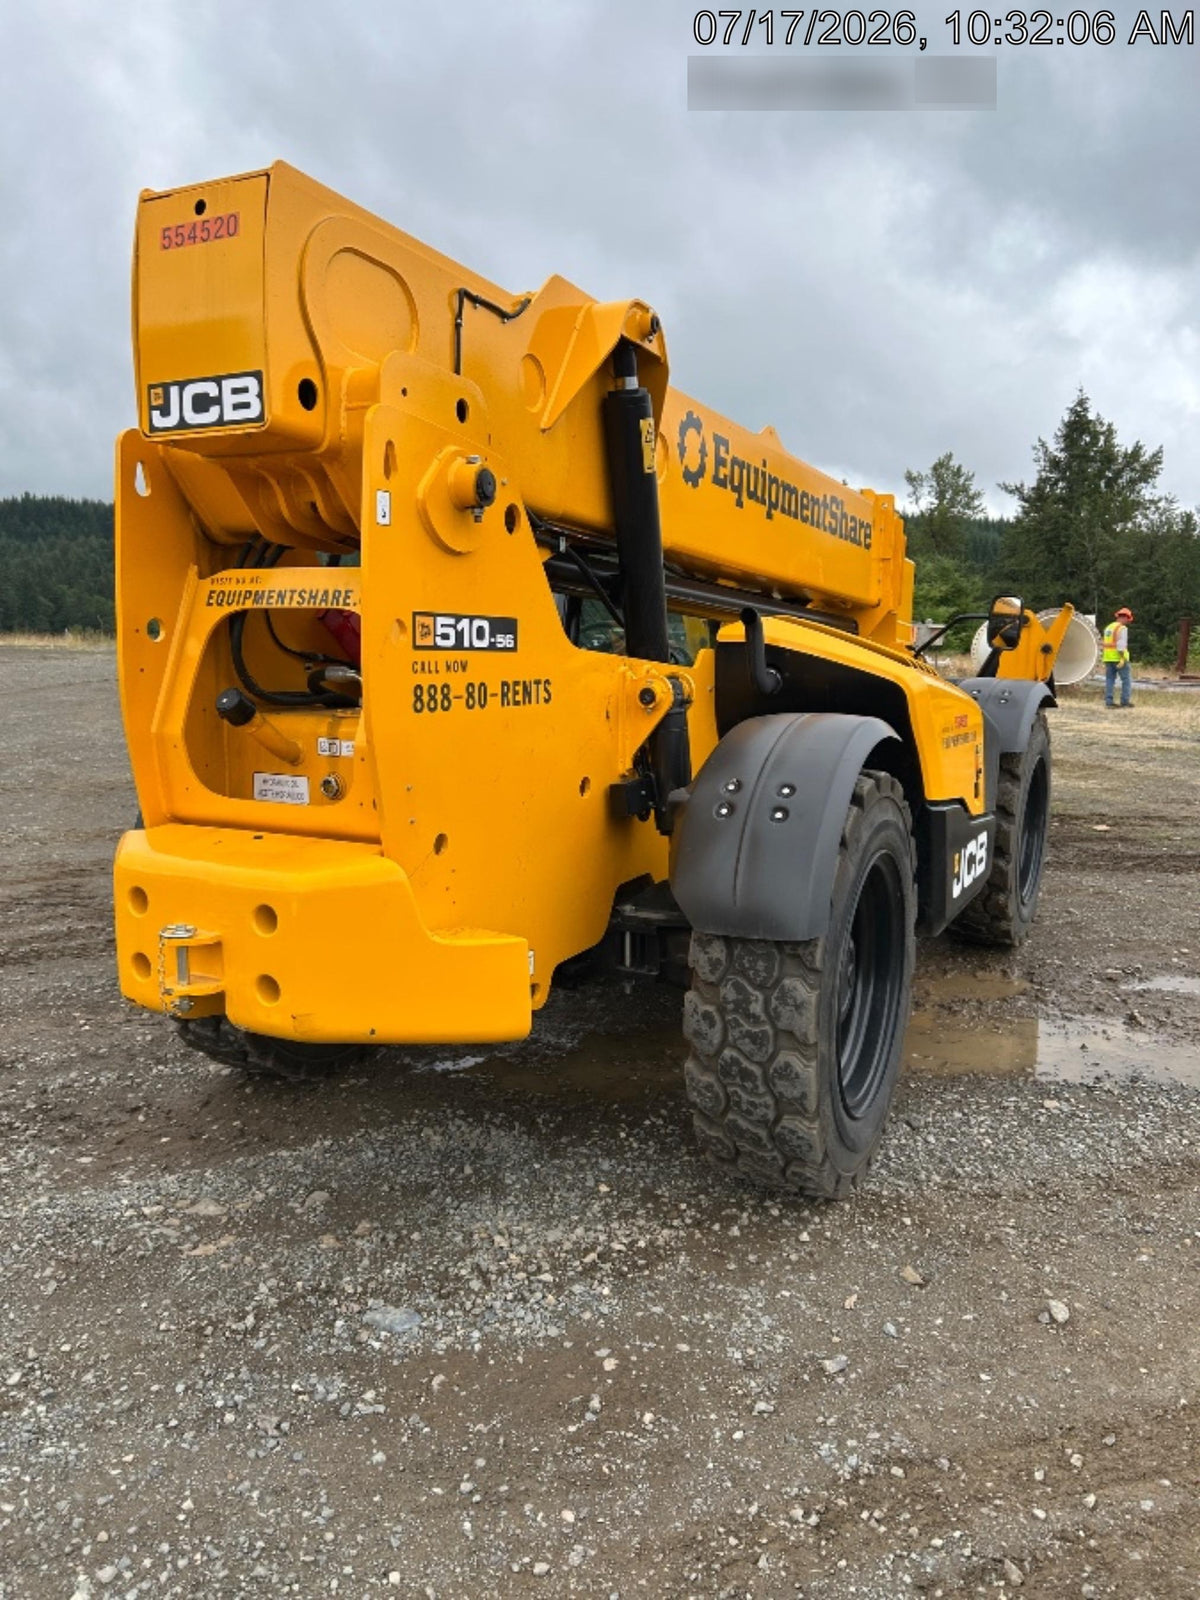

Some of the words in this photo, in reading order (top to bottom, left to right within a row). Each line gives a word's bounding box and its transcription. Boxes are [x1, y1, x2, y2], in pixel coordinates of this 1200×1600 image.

[162, 213, 238, 250] 554520
[150, 376, 262, 428] JCB
[711, 431, 872, 550] EquipmentShare
[205, 589, 361, 607] EQUIPMENTSHARE.
[412, 660, 440, 674] CALL
[445, 659, 469, 673] NOW
[412, 678, 552, 714] 888-80-RENTS
[952, 830, 988, 899] JCB
